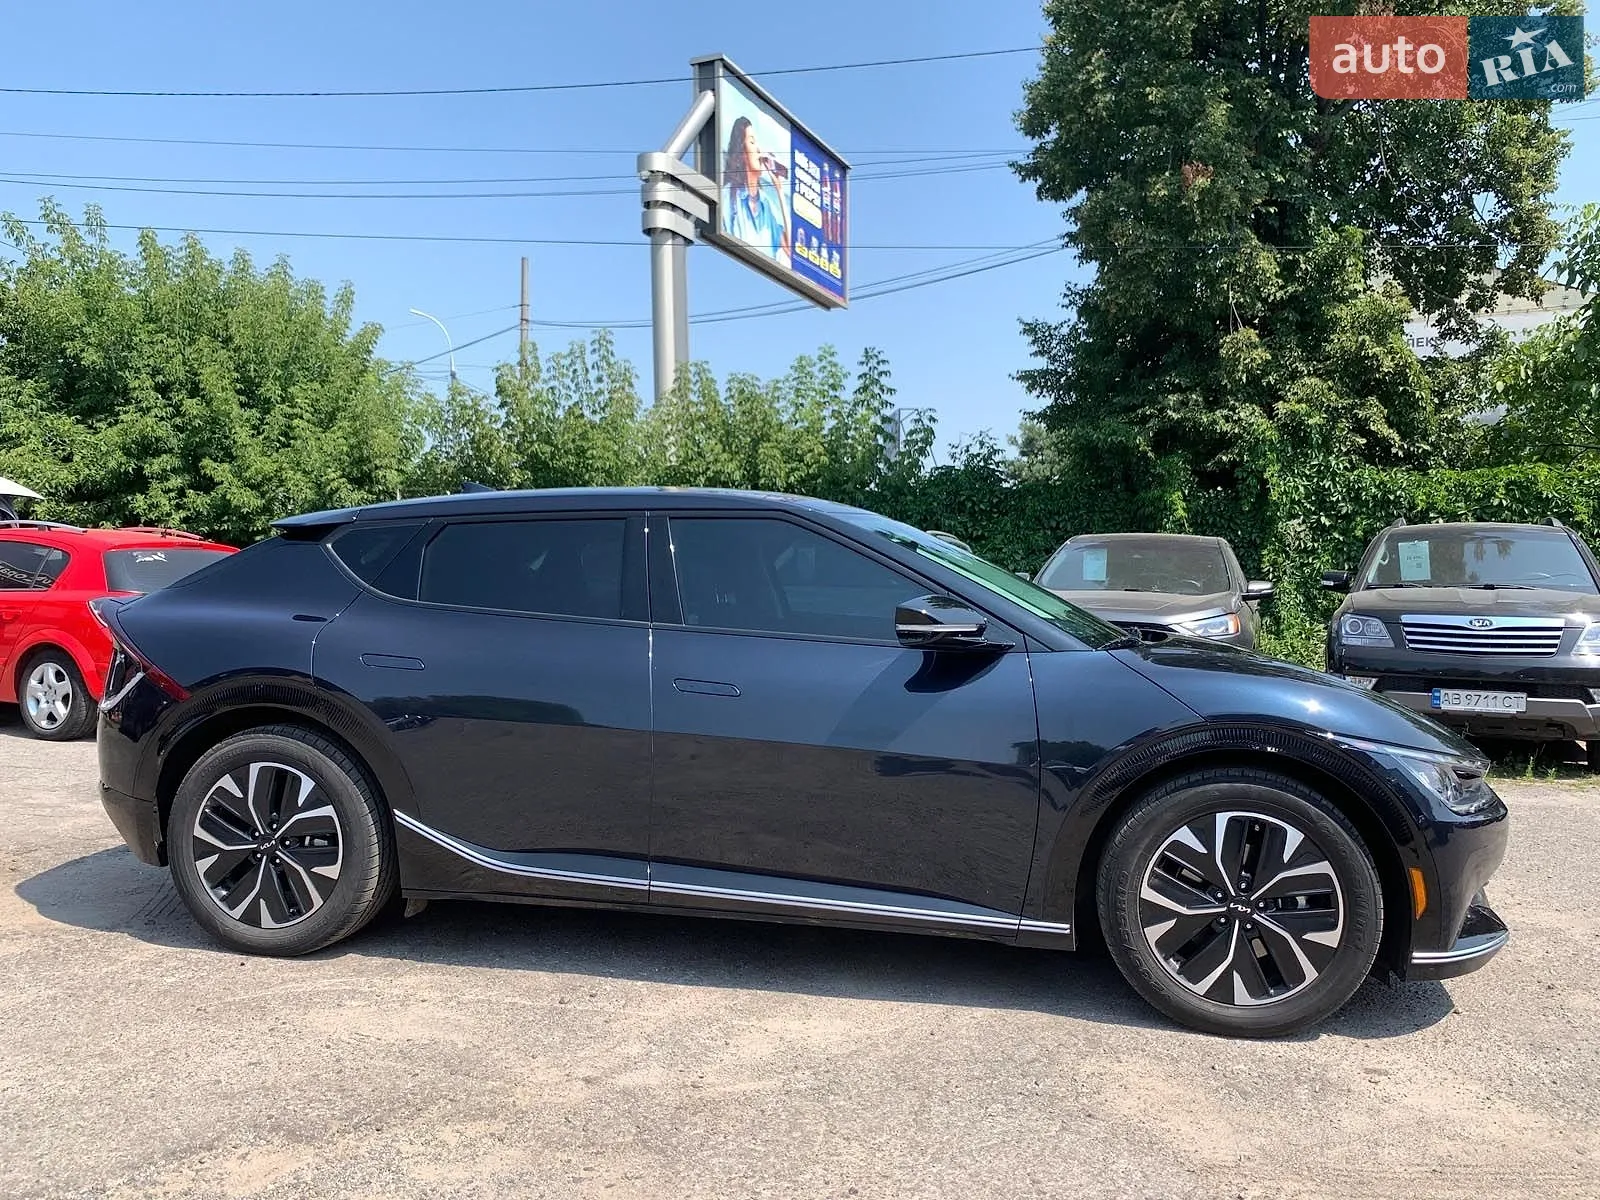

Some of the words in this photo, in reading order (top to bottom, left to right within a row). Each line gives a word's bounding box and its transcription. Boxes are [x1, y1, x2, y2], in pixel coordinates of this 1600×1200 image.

[1442, 692, 1461, 705] AB
[1465, 693, 1498, 709] 9711
[1502, 695, 1524, 709] CT
